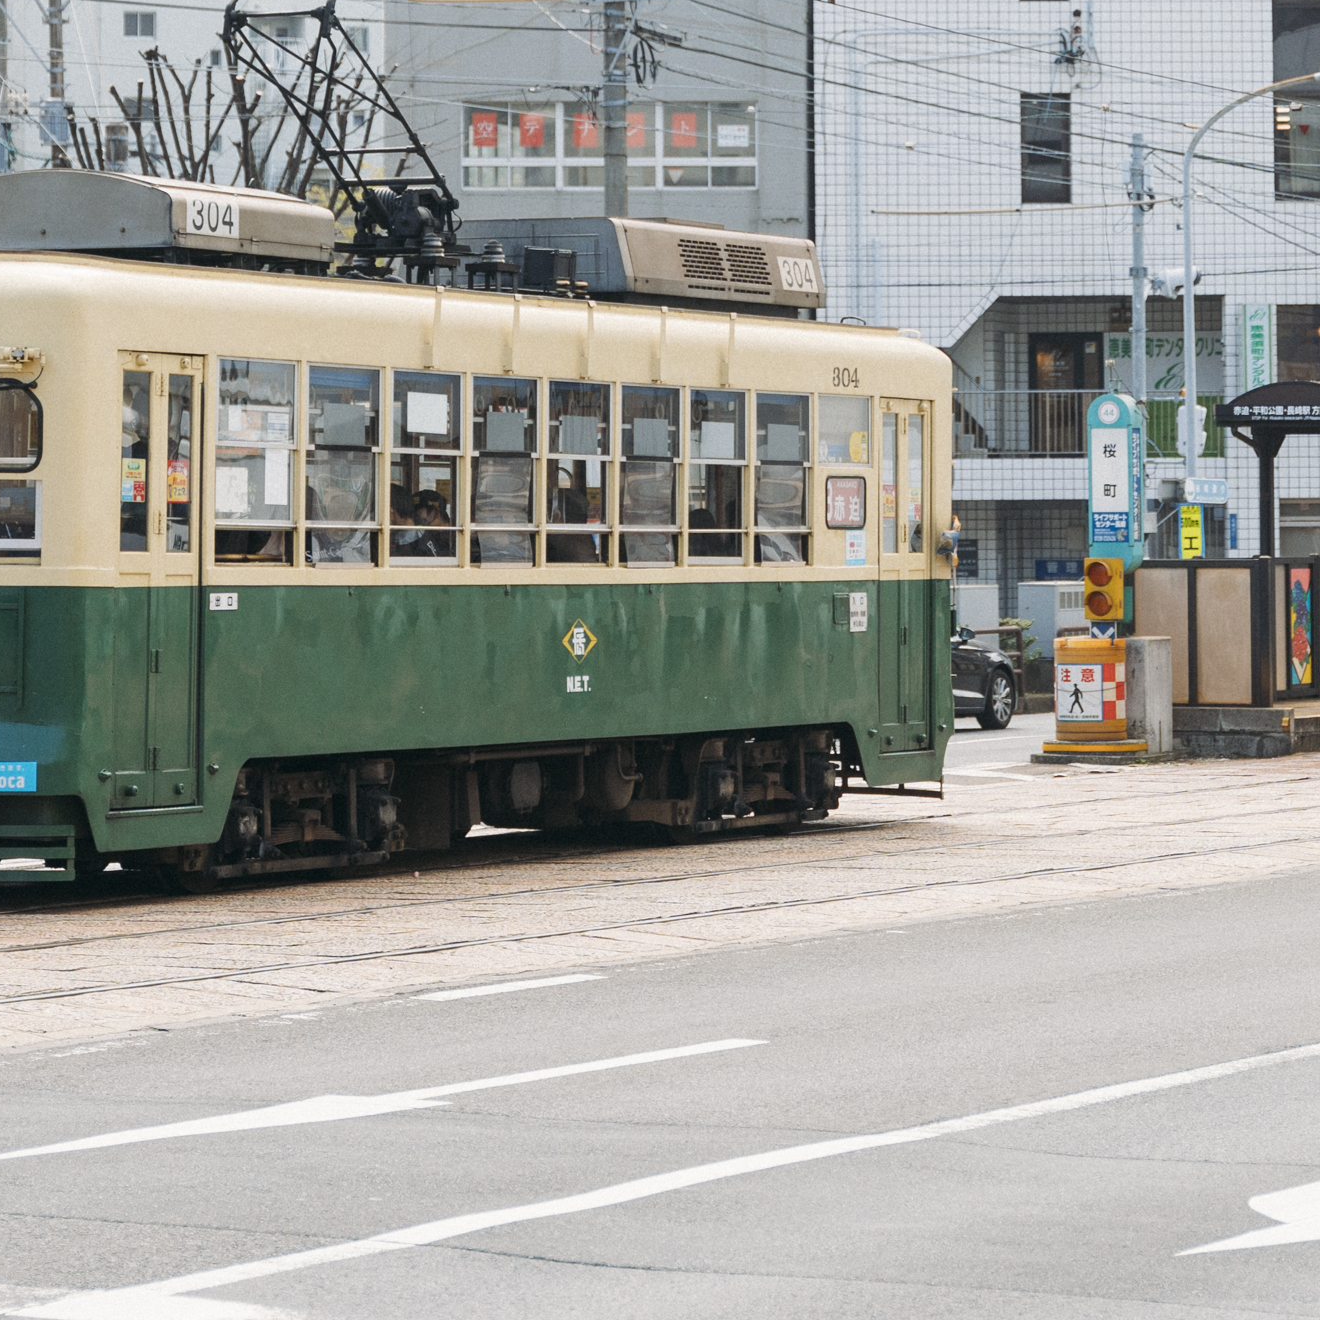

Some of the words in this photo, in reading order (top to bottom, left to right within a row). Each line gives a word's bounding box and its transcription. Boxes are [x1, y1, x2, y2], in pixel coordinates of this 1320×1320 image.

[193, 200, 234, 234] 304
[782, 260, 813, 289] 304
[832, 366, 859, 388] 304
[1233, 406, 1310, 415] 赤迫・平和公園・長崎駅
[1103, 444, 1117, 498] 桜町
[834, 495, 861, 521] 赤迫
[1093, 513, 1128, 521] ライフサポート
[852, 597, 864, 605] 入口
[1061, 668, 1095, 683] 注意
